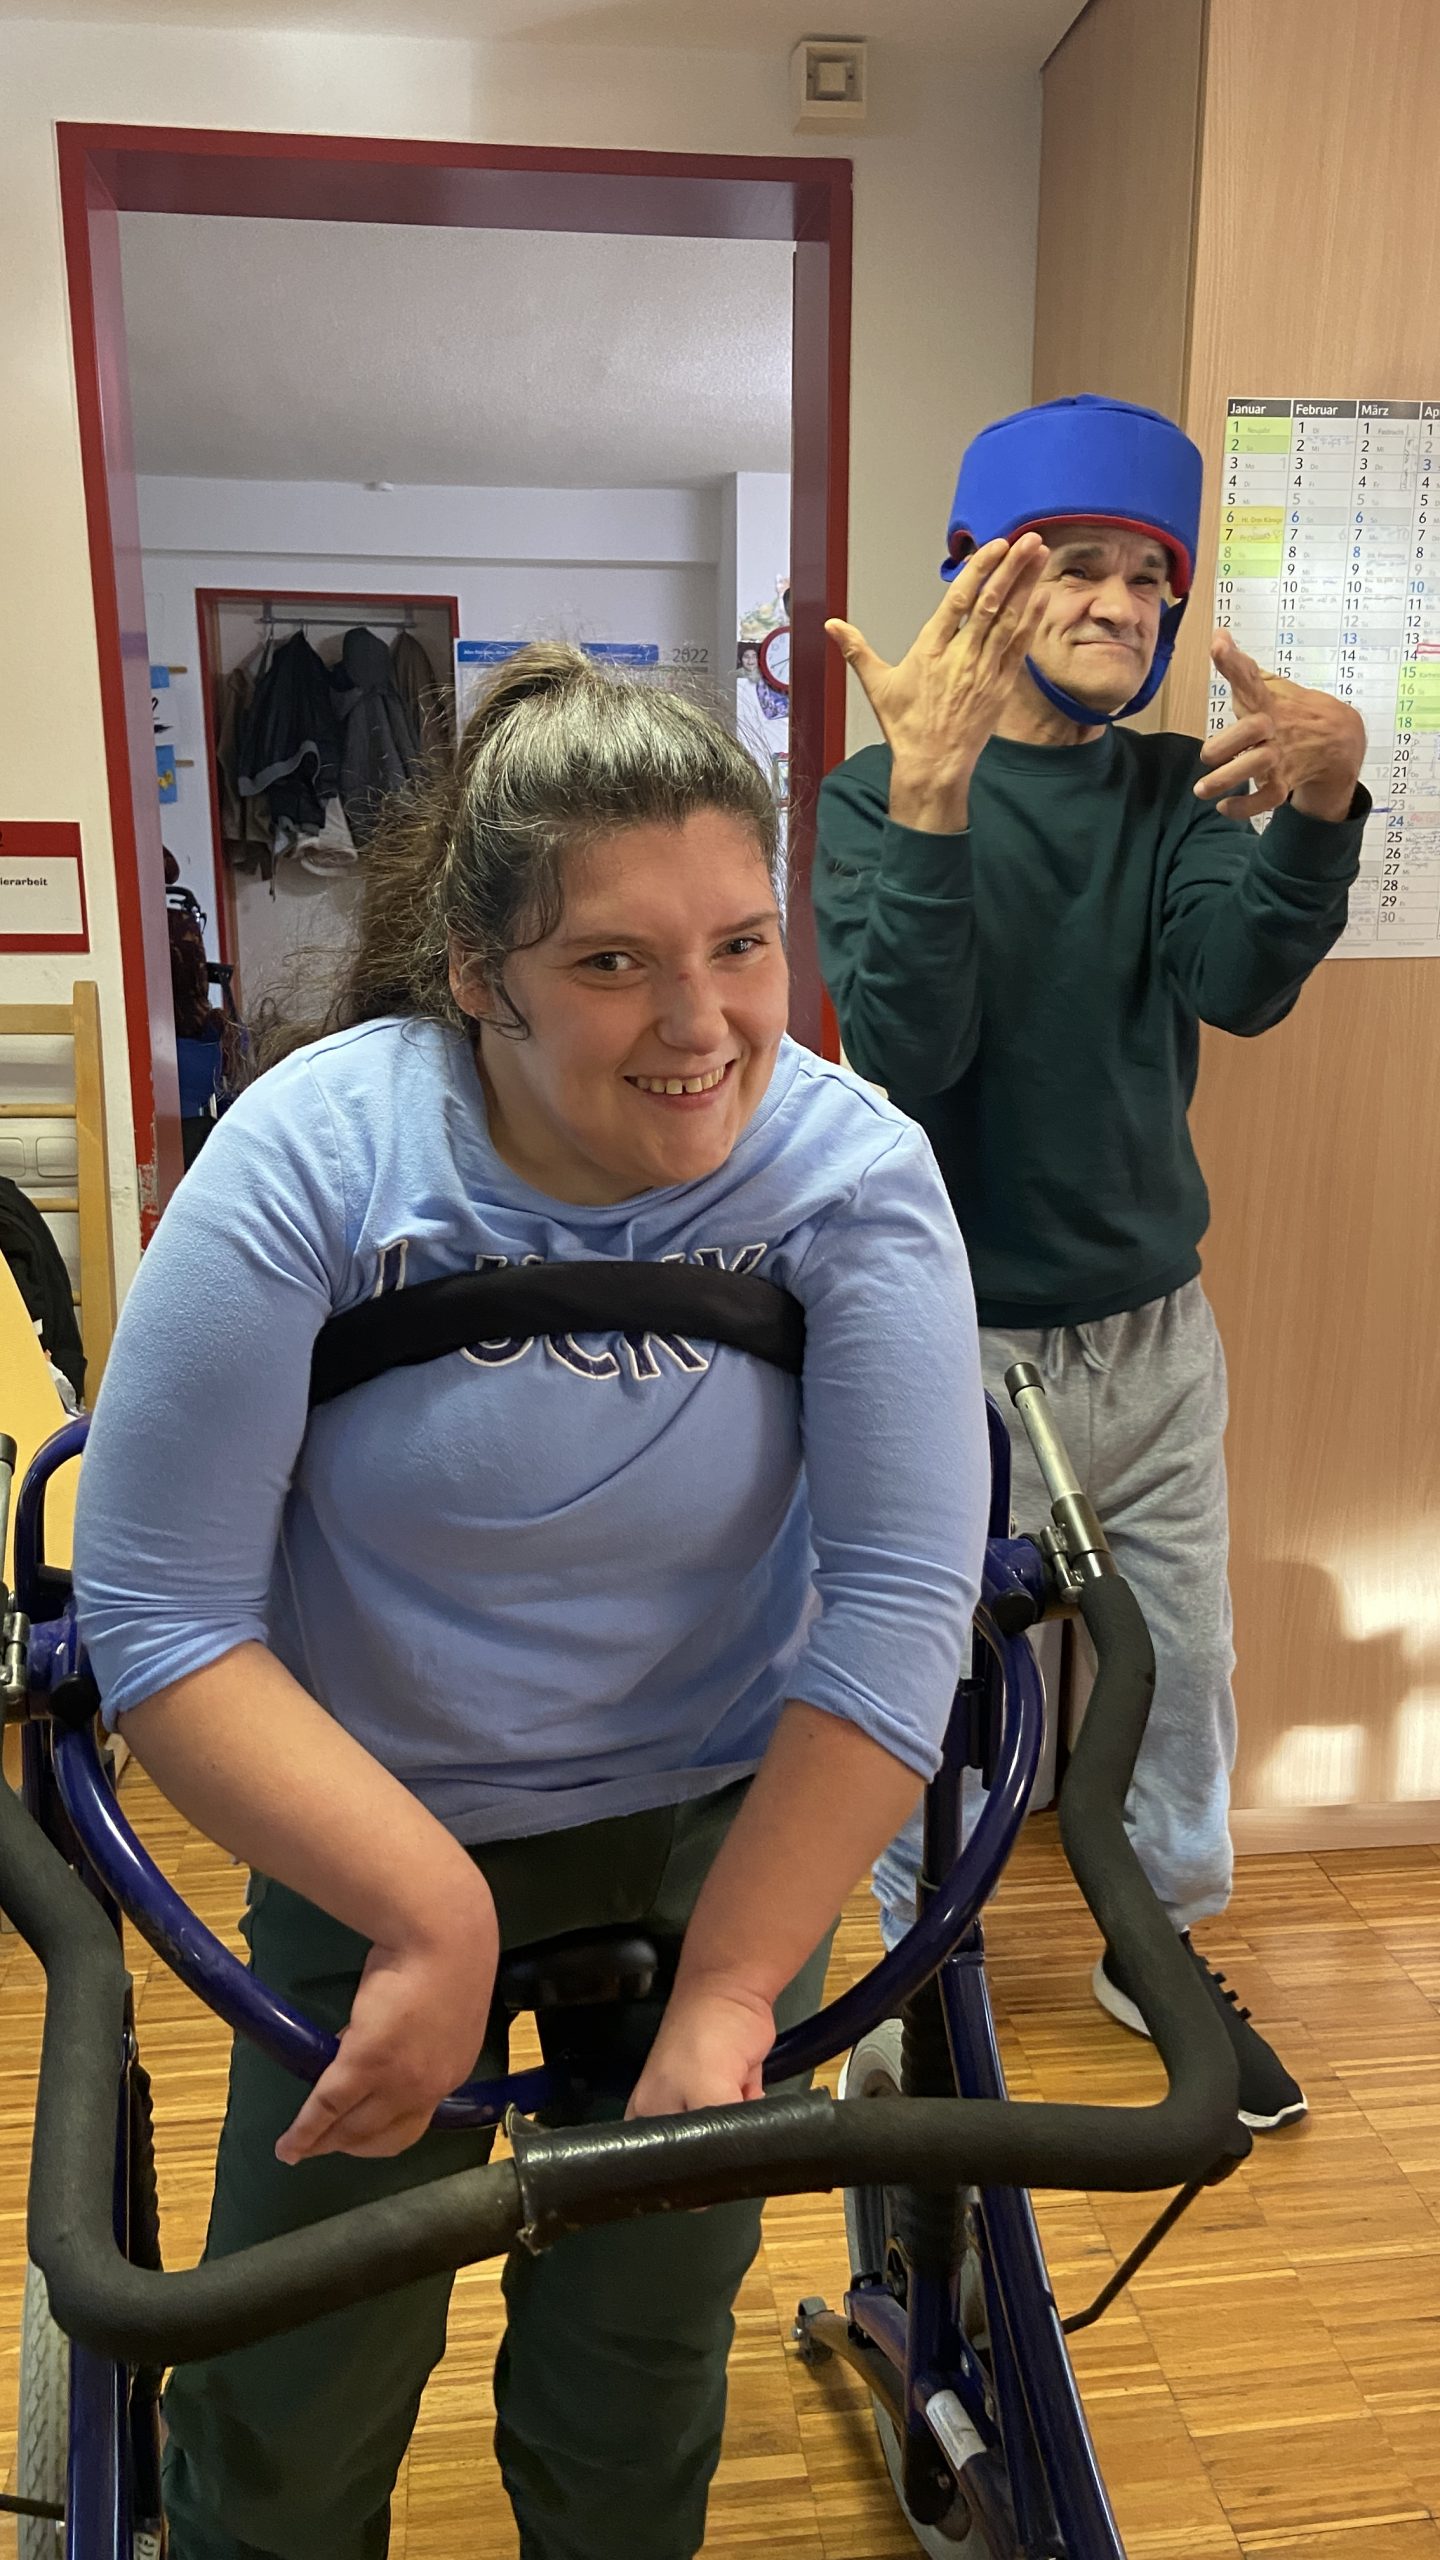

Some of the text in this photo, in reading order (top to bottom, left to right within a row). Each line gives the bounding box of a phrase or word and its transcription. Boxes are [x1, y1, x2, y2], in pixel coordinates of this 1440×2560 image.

[1230, 403, 1266, 414] Januar
[1295, 404, 1338, 415] Februar
[1361, 404, 1389, 416] März
[1233, 421, 1239, 433] 1
[1298, 422, 1304, 433] 1
[1364, 422, 1369, 434] 1
[1427, 424, 1433, 435] 1
[1231, 439, 1239, 451] 2
[1296, 439, 1304, 451] 2
[1361, 440, 1369, 452] 2
[1424, 441, 1432, 453] 2
[1230, 457, 1238, 469] 3
[1295, 457, 1303, 469] 3
[1360, 458, 1368, 470] 3
[1423, 459, 1431, 471] 3
[1229, 475, 1237, 486] 4
[1293, 475, 1302, 487] 4
[1358, 476, 1366, 487] 4
[1422, 476, 1429, 488] 4
[1228, 493, 1236, 505] 5
[1293, 493, 1300, 505] 5
[1357, 493, 1364, 505] 5
[1420, 494, 1428, 506] 5
[1226, 511, 1234, 523] 6
[1291, 511, 1299, 523] 6
[1355, 511, 1363, 523] 6
[1419, 511, 1426, 523] 6
[1226, 529, 1233, 540] 7
[1290, 529, 1298, 540] 7
[1355, 529, 1362, 540] 7
[1418, 530, 1425, 541] 7
[1224, 546, 1231, 558] 8
[1288, 546, 1296, 558] 8
[1353, 546, 1360, 558] 8
[1416, 547, 1424, 558] 8
[1223, 564, 1231, 575] 9
[1287, 564, 1295, 575] 9
[1352, 563, 1359, 575] 9
[1415, 564, 1422, 575] 9
[1218, 581, 1233, 593] 10
[1283, 581, 1298, 593] 10
[1347, 581, 1362, 593] 10
[1410, 581, 1424, 593] 10
[1217, 599, 1231, 610] 11
[1281, 599, 1295, 610] 11
[1346, 599, 1359, 610] 11
[1408, 599, 1421, 610] 11
[1216, 616, 1231, 627] 12
[1280, 616, 1295, 627] 12
[1344, 616, 1358, 627] 12
[1407, 616, 1421, 627] 12
[1279, 633, 1293, 644] 13
[1343, 632, 1357, 644] 13
[1405, 632, 1419, 644] 13
[672, 648, 709, 664] 2022
[1278, 650, 1292, 661] 14
[1341, 650, 1356, 661] 14
[1404, 650, 1417, 661] 14
[1277, 667, 1291, 678] 15
[1340, 667, 1354, 678] 15
[1402, 666, 1416, 678] 15
[1212, 684, 1226, 696] 16
[1338, 684, 1353, 695] 16
[1400, 684, 1414, 695] 16
[1210, 701, 1225, 712] 17
[1399, 700, 1414, 711] 17
[1210, 718, 1224, 729] 18
[1397, 717, 1412, 728] 18
[1396, 733, 1411, 745] 19
[1394, 749, 1409, 761] 20
[1392, 766, 1407, 778] 21
[1391, 783, 1407, 794] 22
[1391, 799, 1405, 810] 23
[1388, 815, 1404, 827] 24
[1387, 832, 1403, 843] 25
[1385, 848, 1401, 859] 26
[1384, 864, 1400, 875] 27
[1382, 880, 1398, 891] 28
[1381, 895, 1397, 907] 29
[1380, 912, 1396, 923] 30
